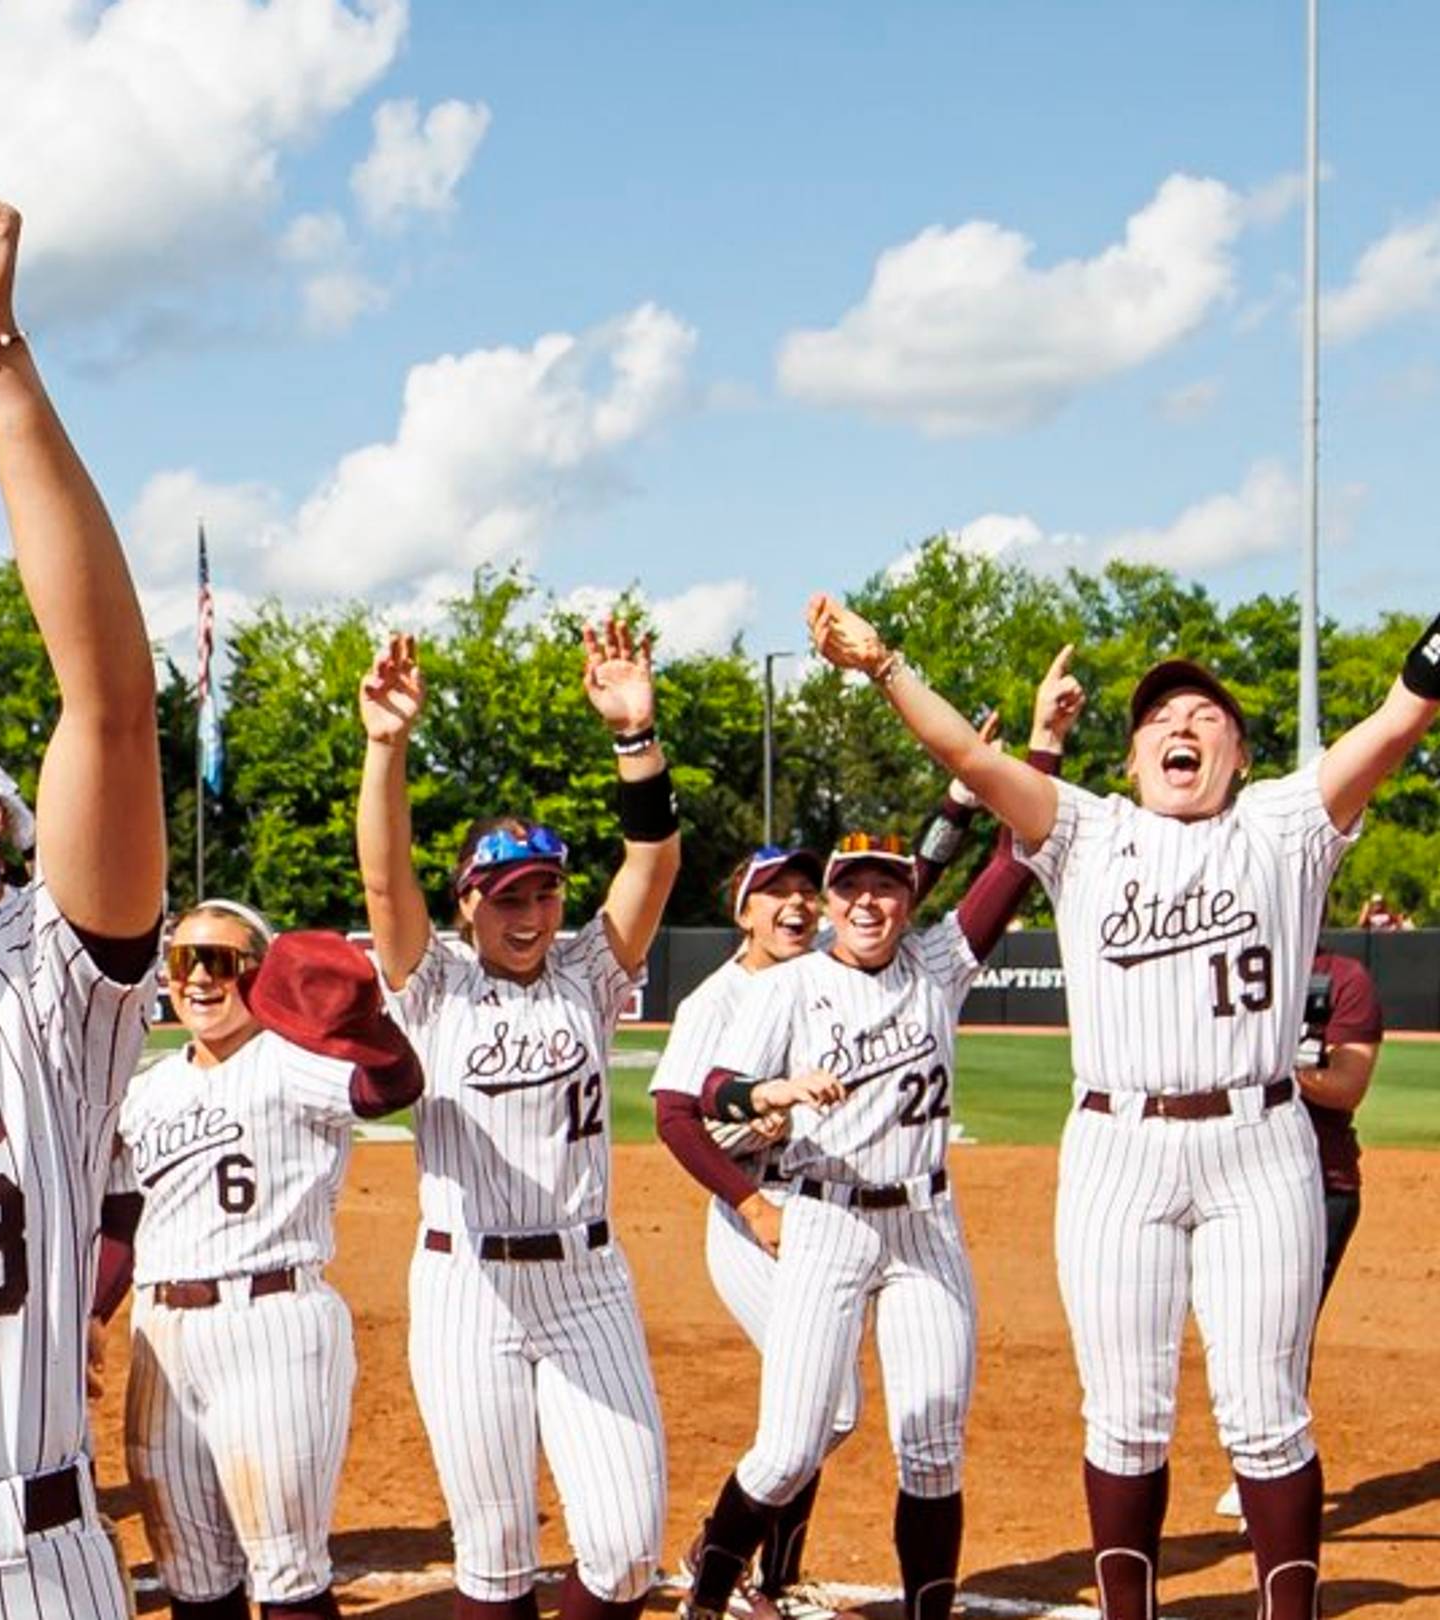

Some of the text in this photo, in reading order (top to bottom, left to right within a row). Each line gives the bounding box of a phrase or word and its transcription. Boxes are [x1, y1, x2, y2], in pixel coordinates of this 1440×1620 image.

[1100, 879, 1257, 962] State
[1209, 945, 1273, 1017] 19
[819, 1015, 937, 1085] State
[567, 1072, 603, 1143] 12
[899, 1064, 950, 1127] 22
[134, 1105, 244, 1180] State
[216, 1153, 255, 1214] 6
